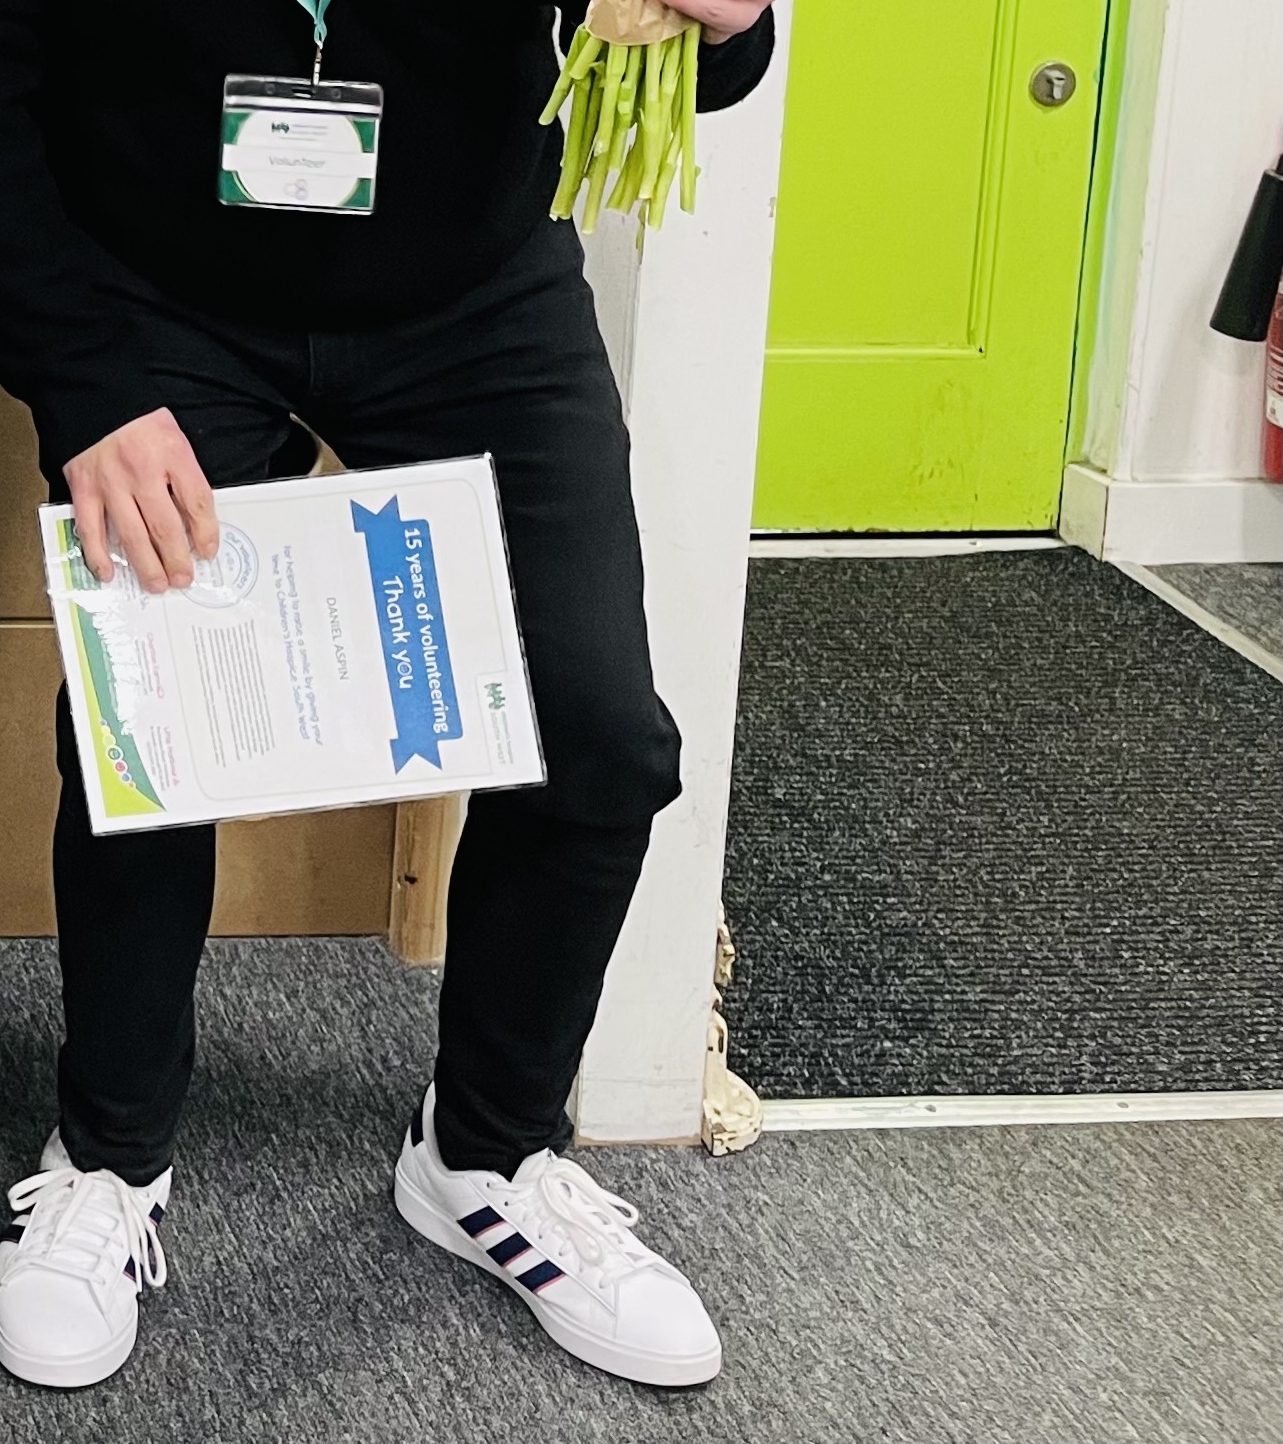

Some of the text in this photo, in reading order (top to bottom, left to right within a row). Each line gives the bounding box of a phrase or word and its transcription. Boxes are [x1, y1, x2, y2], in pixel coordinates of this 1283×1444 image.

[276, 590, 290, 639] Children's
[283, 640, 297, 683] Hospice
[292, 685, 304, 714] South
[285, 561, 298, 598] helping
[305, 676, 313, 689] by
[326, 597, 349, 681] DANIEL ASPIN
[382, 575, 414, 689] Thank you
[404, 527, 449, 733] 15 years of volunteering
